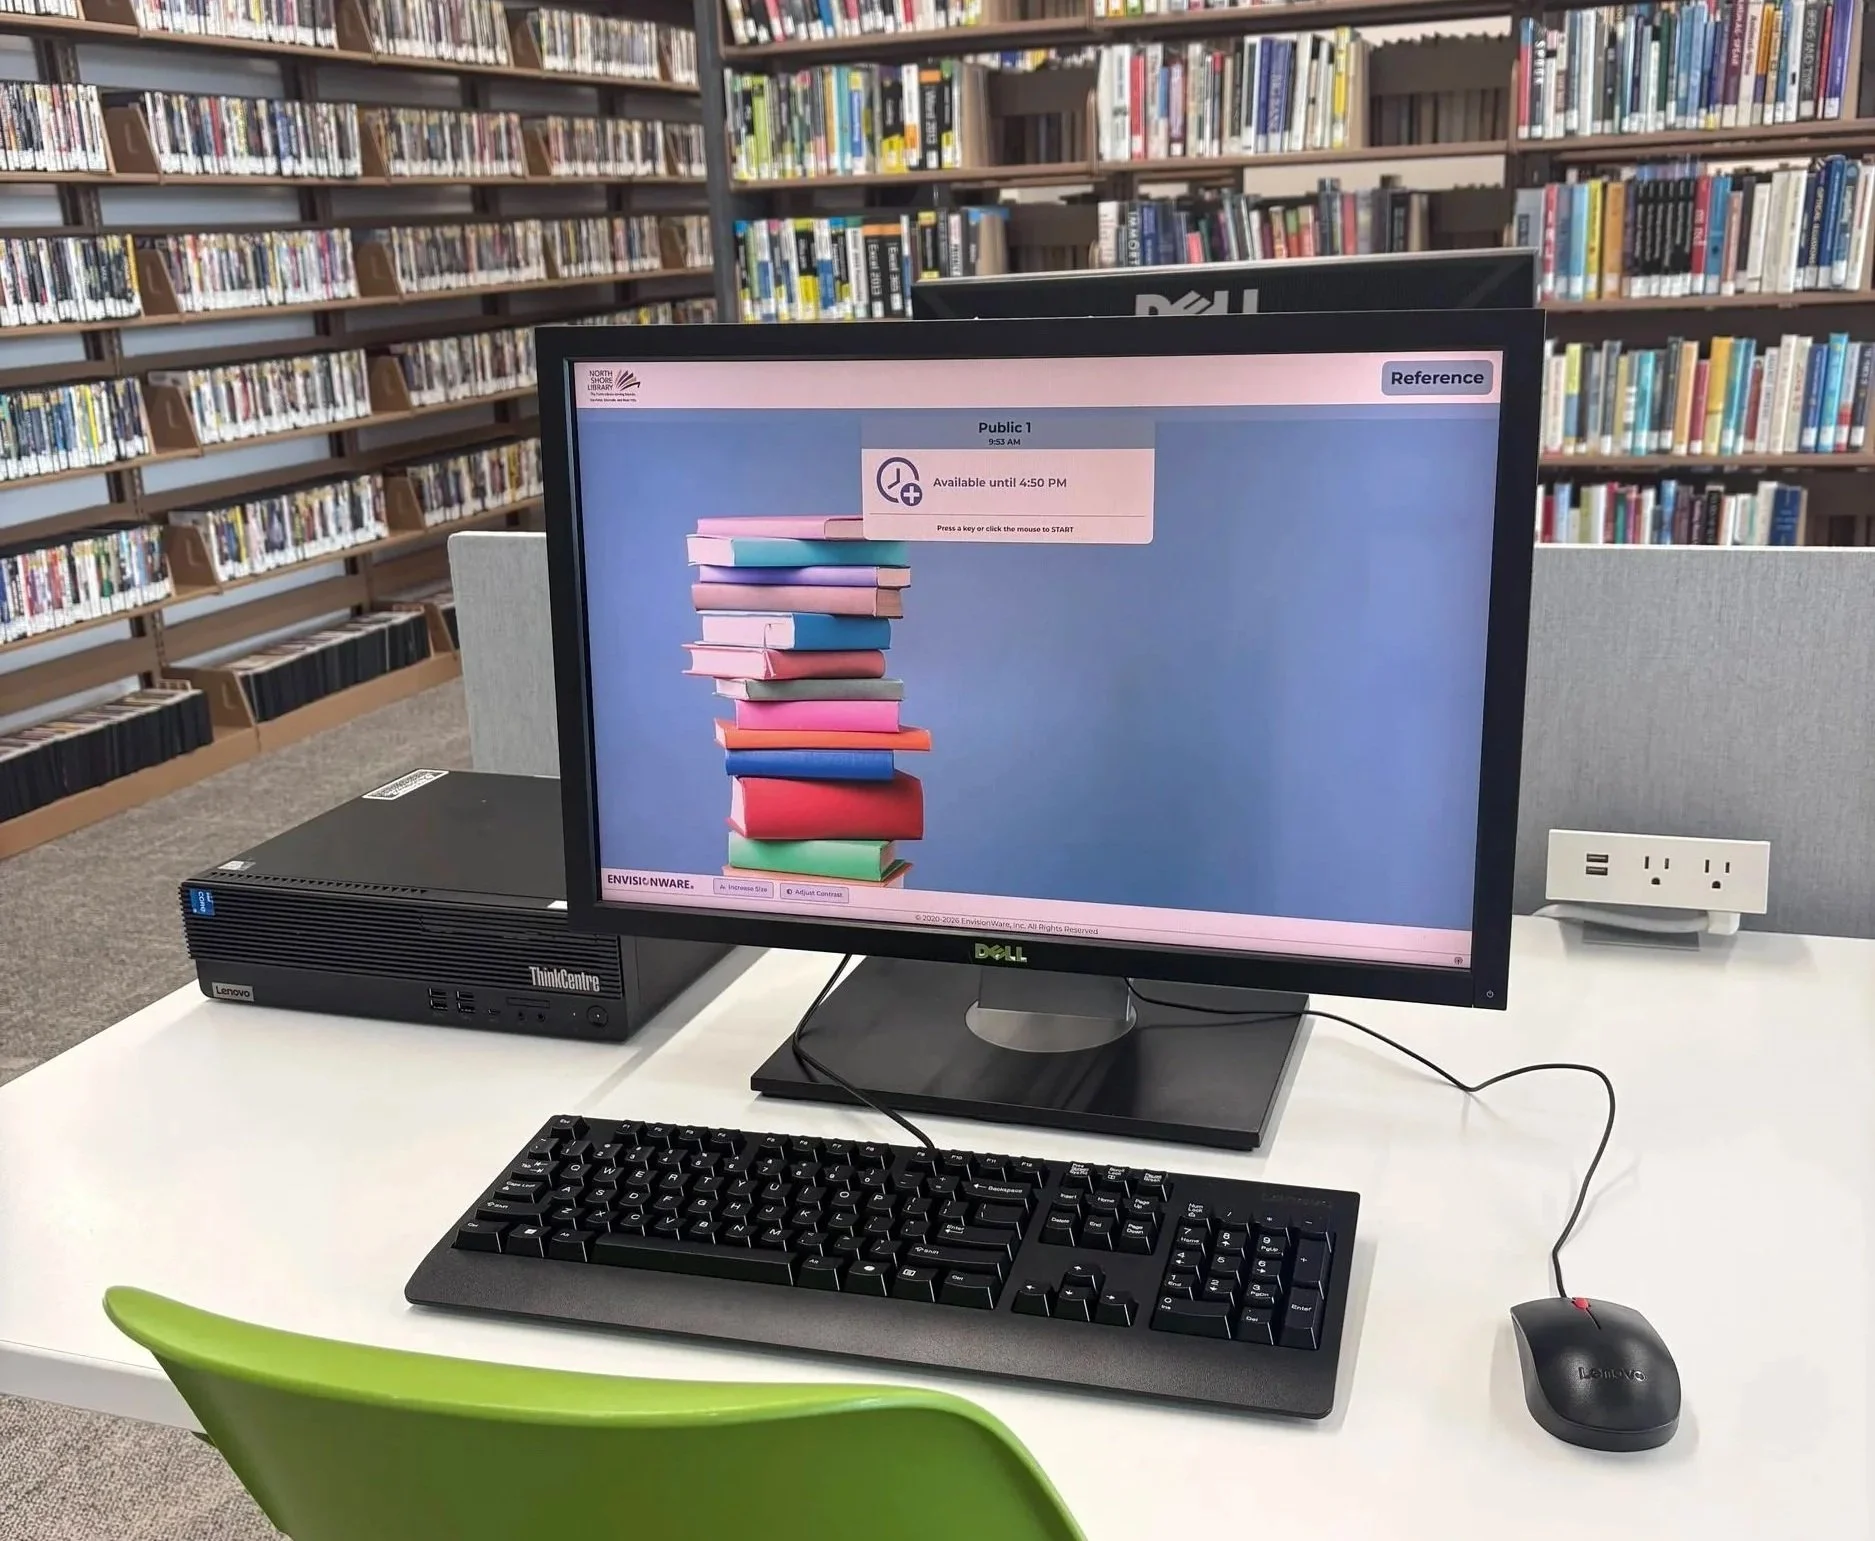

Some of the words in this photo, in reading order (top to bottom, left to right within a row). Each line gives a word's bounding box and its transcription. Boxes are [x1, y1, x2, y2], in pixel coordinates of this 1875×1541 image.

[1804, 42, 1815, 65] AND
[1135, 289, 1259, 317] DELL
[1391, 371, 1484, 385] Reference
[978, 422, 1022, 434] Public
[1025, 422, 1031, 433] 1
[988, 438, 1006, 446] 9:53
[1007, 438, 1021, 446] AM
[933, 477, 986, 488] Available
[989, 477, 1017, 488] until
[1019, 478, 1045, 488] 4:50
[1048, 478, 1067, 488] PM
[963, 525, 976, 534] key
[985, 525, 1002, 533] click
[1003, 525, 1016, 533] the
[728, 884, 754, 892] Increase
[755, 885, 768, 893] Size
[795, 888, 815, 898] Adjust
[816, 890, 843, 898] Contrast
[922, 915, 960, 924] 2020-2026
[961, 917, 1012, 929] EnvisionWare,
[1013, 921, 1026, 929] Inc.
[1027, 923, 1037, 931] All
[1038, 923, 1063, 934] Rights
[1064, 925, 1099, 935] Reserved
[974, 943, 1028, 963] DELL
[529, 966, 600, 992] ThinkCentre
[214, 984, 251, 998] Lenovo
[603, 1167, 616, 1175] W
[635, 1170, 645, 1178] E
[668, 1173, 678, 1181] R
[704, 1176, 712, 1184] T
[769, 1183, 779, 1191] U
[988, 1185, 1023, 1194] Backspace
[1223, 1232, 1231, 1240] 8
[1291, 1303, 1312, 1312] Enter
[1578, 1366, 1646, 1382] Lenovo
